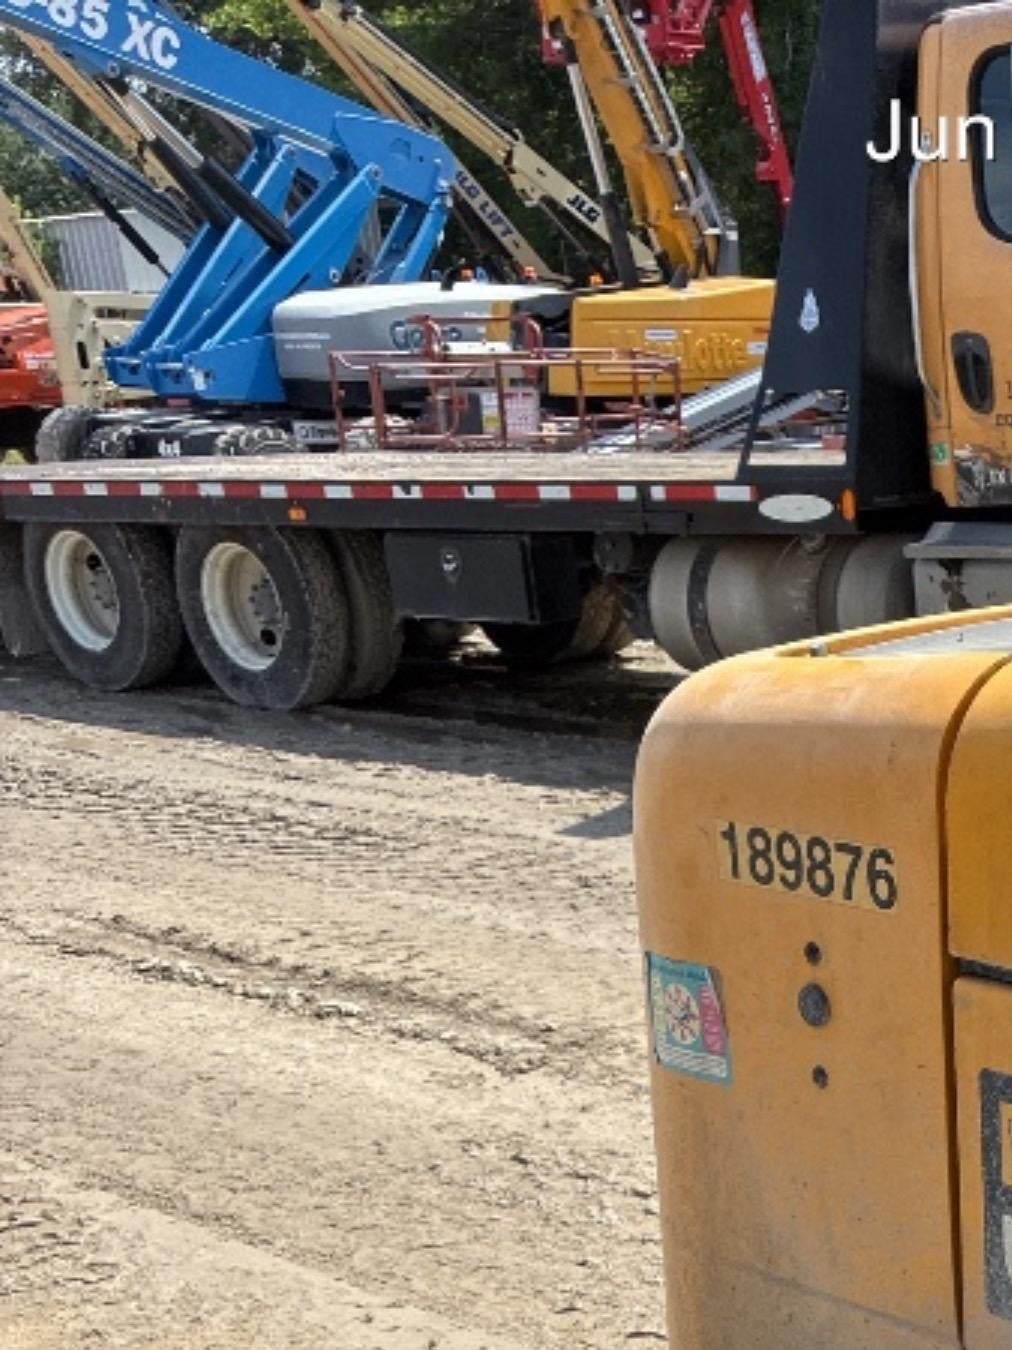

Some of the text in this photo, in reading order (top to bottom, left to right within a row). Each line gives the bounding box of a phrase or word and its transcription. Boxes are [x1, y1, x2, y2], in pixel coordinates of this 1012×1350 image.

[121, 11, 181, 70] XC
[566, 194, 601, 223] JLG
[390, 320, 462, 351] Gee
[720, 821, 898, 910] 189876
